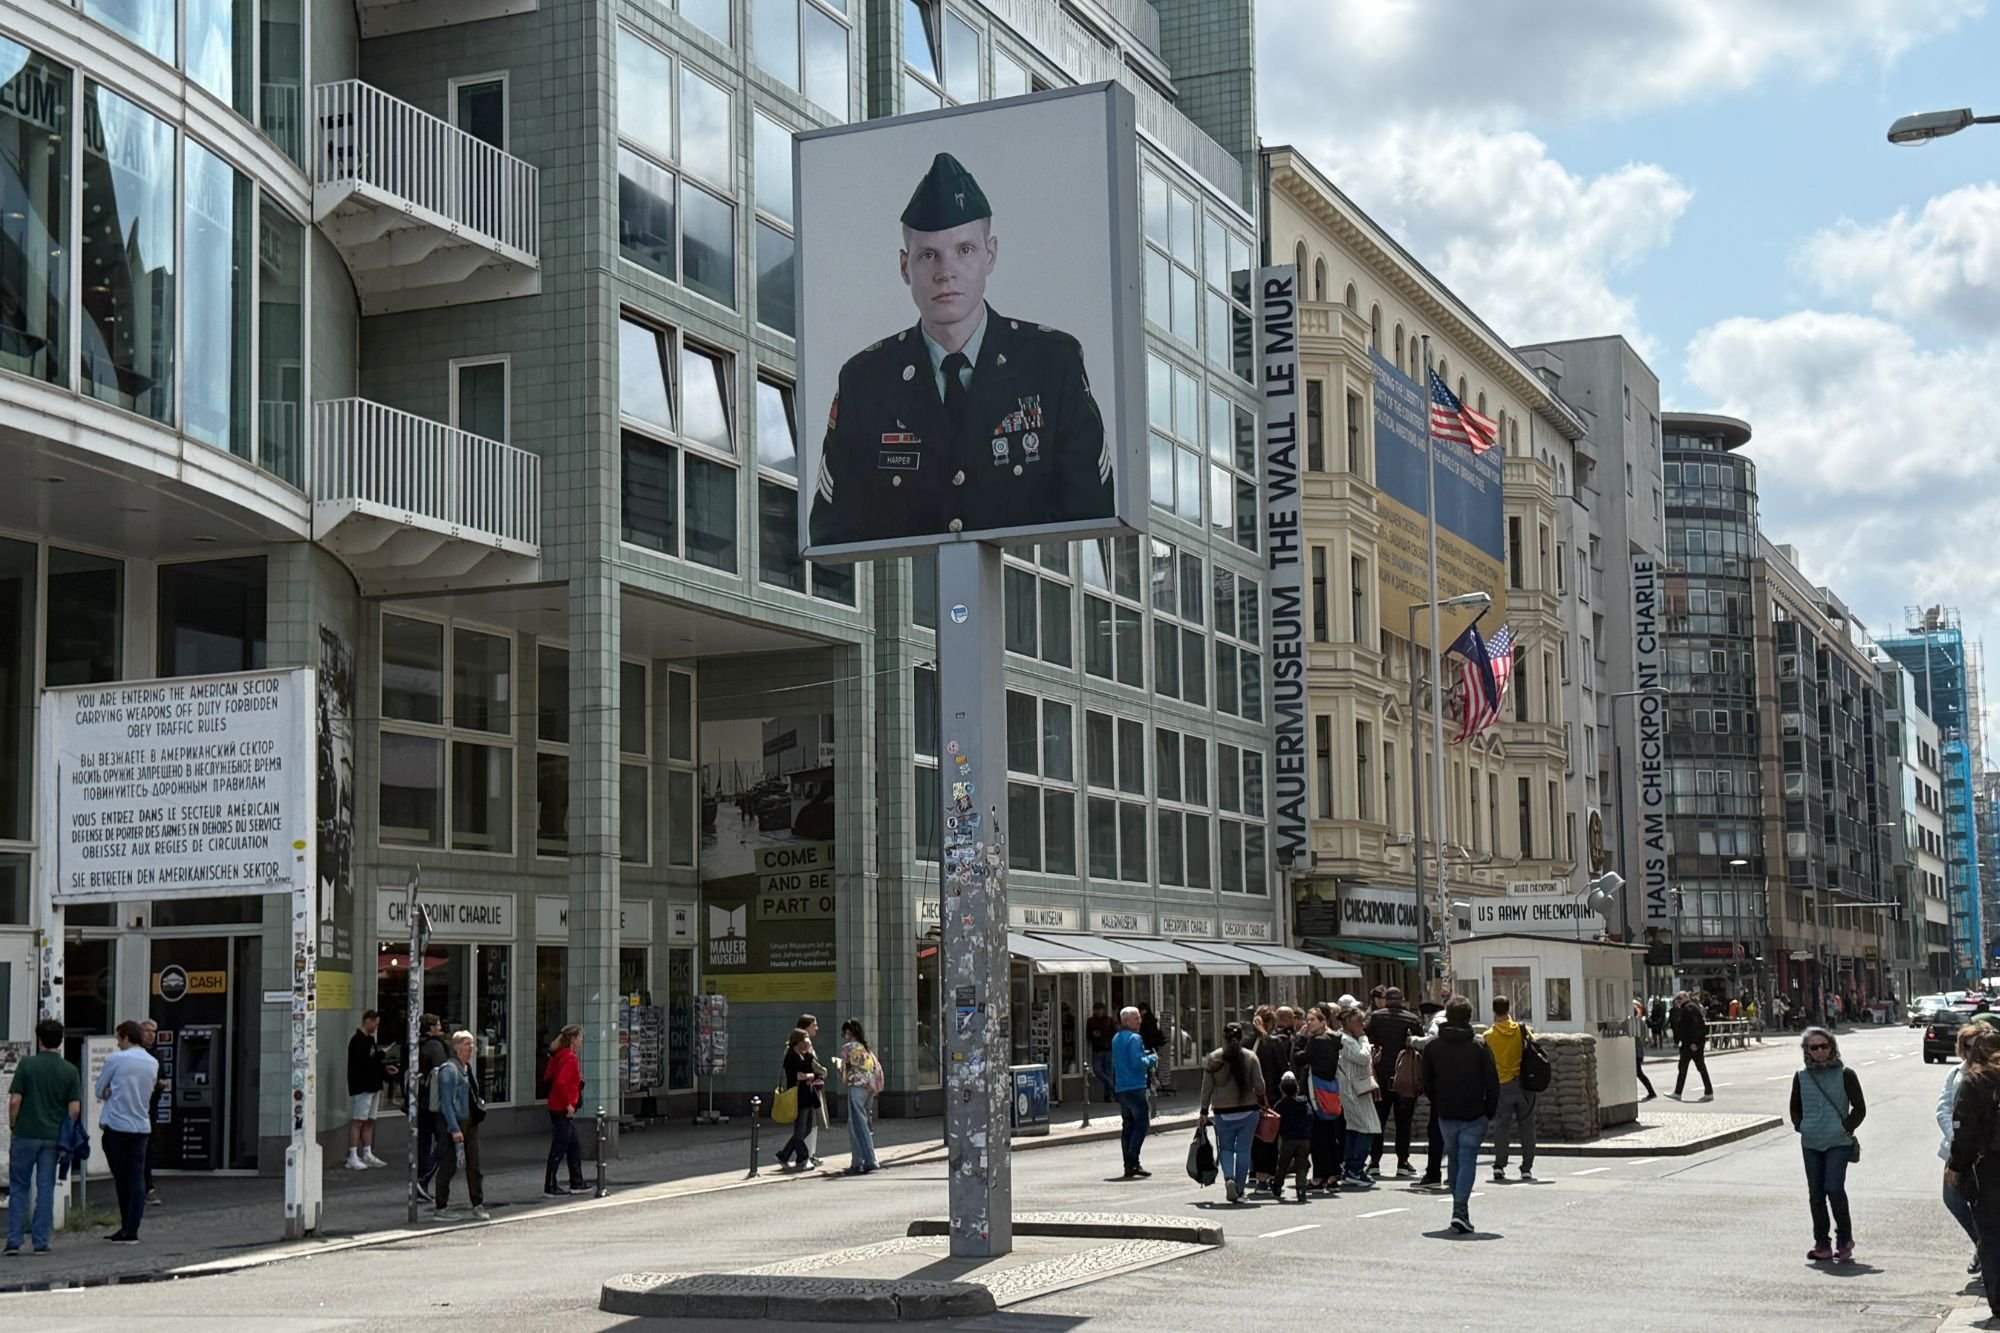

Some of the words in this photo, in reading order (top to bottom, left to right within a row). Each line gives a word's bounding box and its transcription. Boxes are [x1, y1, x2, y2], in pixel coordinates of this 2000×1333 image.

[1264, 276, 1294, 354] MUR
[1266, 363, 1295, 398] LE
[1267, 412, 1297, 503] WALL
[1268, 510, 1298, 570] THE
[1634, 561, 1657, 654] CHARLIE
[76, 694, 95, 708] YOU
[99, 691, 117, 707] ARE
[122, 688, 165, 705] ENTERING
[170, 686, 184, 701] THE
[190, 682, 238, 699] AMERICAN
[243, 678, 280, 696] SECTOR
[75, 709, 123, 725] CARRYING
[126, 705, 172, 721] WEAPONS
[176, 703, 193, 718] OFF
[198, 700, 221, 716] DUTY
[225, 696, 278, 713] FORBIDDEN
[1272, 585, 1306, 857] MAUERMUSEUM
[127, 723, 152, 738] OBEY
[157, 720, 193, 736] TRAFFIC
[198, 717, 227, 733] RULES
[1638, 662, 1662, 807] CHECKPONT
[80, 753, 95, 768] ВЫ
[150, 748, 157, 763] В
[161, 740, 236, 762] АМЕРИКАНСКИЙ
[240, 740, 275, 756] СЕКТОР
[72, 770, 102, 785] НОСИТЬ
[103, 767, 134, 783] ОРУЖИЕ
[186, 763, 192, 777] В
[254, 756, 282, 773] ВРЕМЯ
[152, 779, 207, 797] ДОРОЖНЫМ
[213, 776, 266, 793] ПРАВИЛАМ
[72, 812, 96, 827] VOUS
[101, 810, 134, 826] ENTREZ
[139, 808, 163, 823] DANS
[168, 807, 177, 821] LE
[181, 804, 222, 821] SECTEUR
[72, 828, 103, 844] DEFENSE
[105, 828, 114, 841] DE
[116, 825, 144, 841] PORTER
[145, 824, 160, 839] DES
[161, 823, 187, 837] ARMES
[188, 822, 199, 836] EN
[202, 819, 233, 835] DEHORS
[235, 819, 247, 833] DU
[249, 817, 282, 832] SERVICE
[1643, 813, 1665, 851] AM
[82, 843, 127, 860] OBEISSEZ
[131, 842, 150, 856] AUX
[155, 839, 188, 855] REGLES
[192, 838, 203, 853] DE
[208, 835, 269, 852] CIRCULATION
[764, 848, 817, 868] COME
[72, 872, 86, 888] SIE
[90, 870, 133, 887] BETRETEN
[137, 868, 155, 884] DEN
[158, 863, 239, 883] AMERIKANISCHEN
[243, 861, 279, 879] SEKTOR
[768, 876, 801, 892] AND
[809, 874, 830, 889] BE
[1529, 882, 1557, 893] CHECKPOINT
[1647, 858, 1668, 918] HAUS
[388, 902, 456, 923] CHPOINT
[459, 904, 501, 925] CHARLIE
[763, 897, 810, 914] PART
[1024, 910, 1040, 924] WALL
[1040, 911, 1063, 926] MUSEUM
[1344, 897, 1395, 926] CHECKPOINT
[1478, 906, 1494, 921] US
[1498, 904, 1528, 921] ARMY
[1163, 918, 1190, 933] CHECKPOINT
[1190, 919, 1208, 934] CHARLIE
[709, 940, 746, 953] MAUER
[709, 953, 747, 965] MUSEUM
[190, 975, 223, 990] CASH
